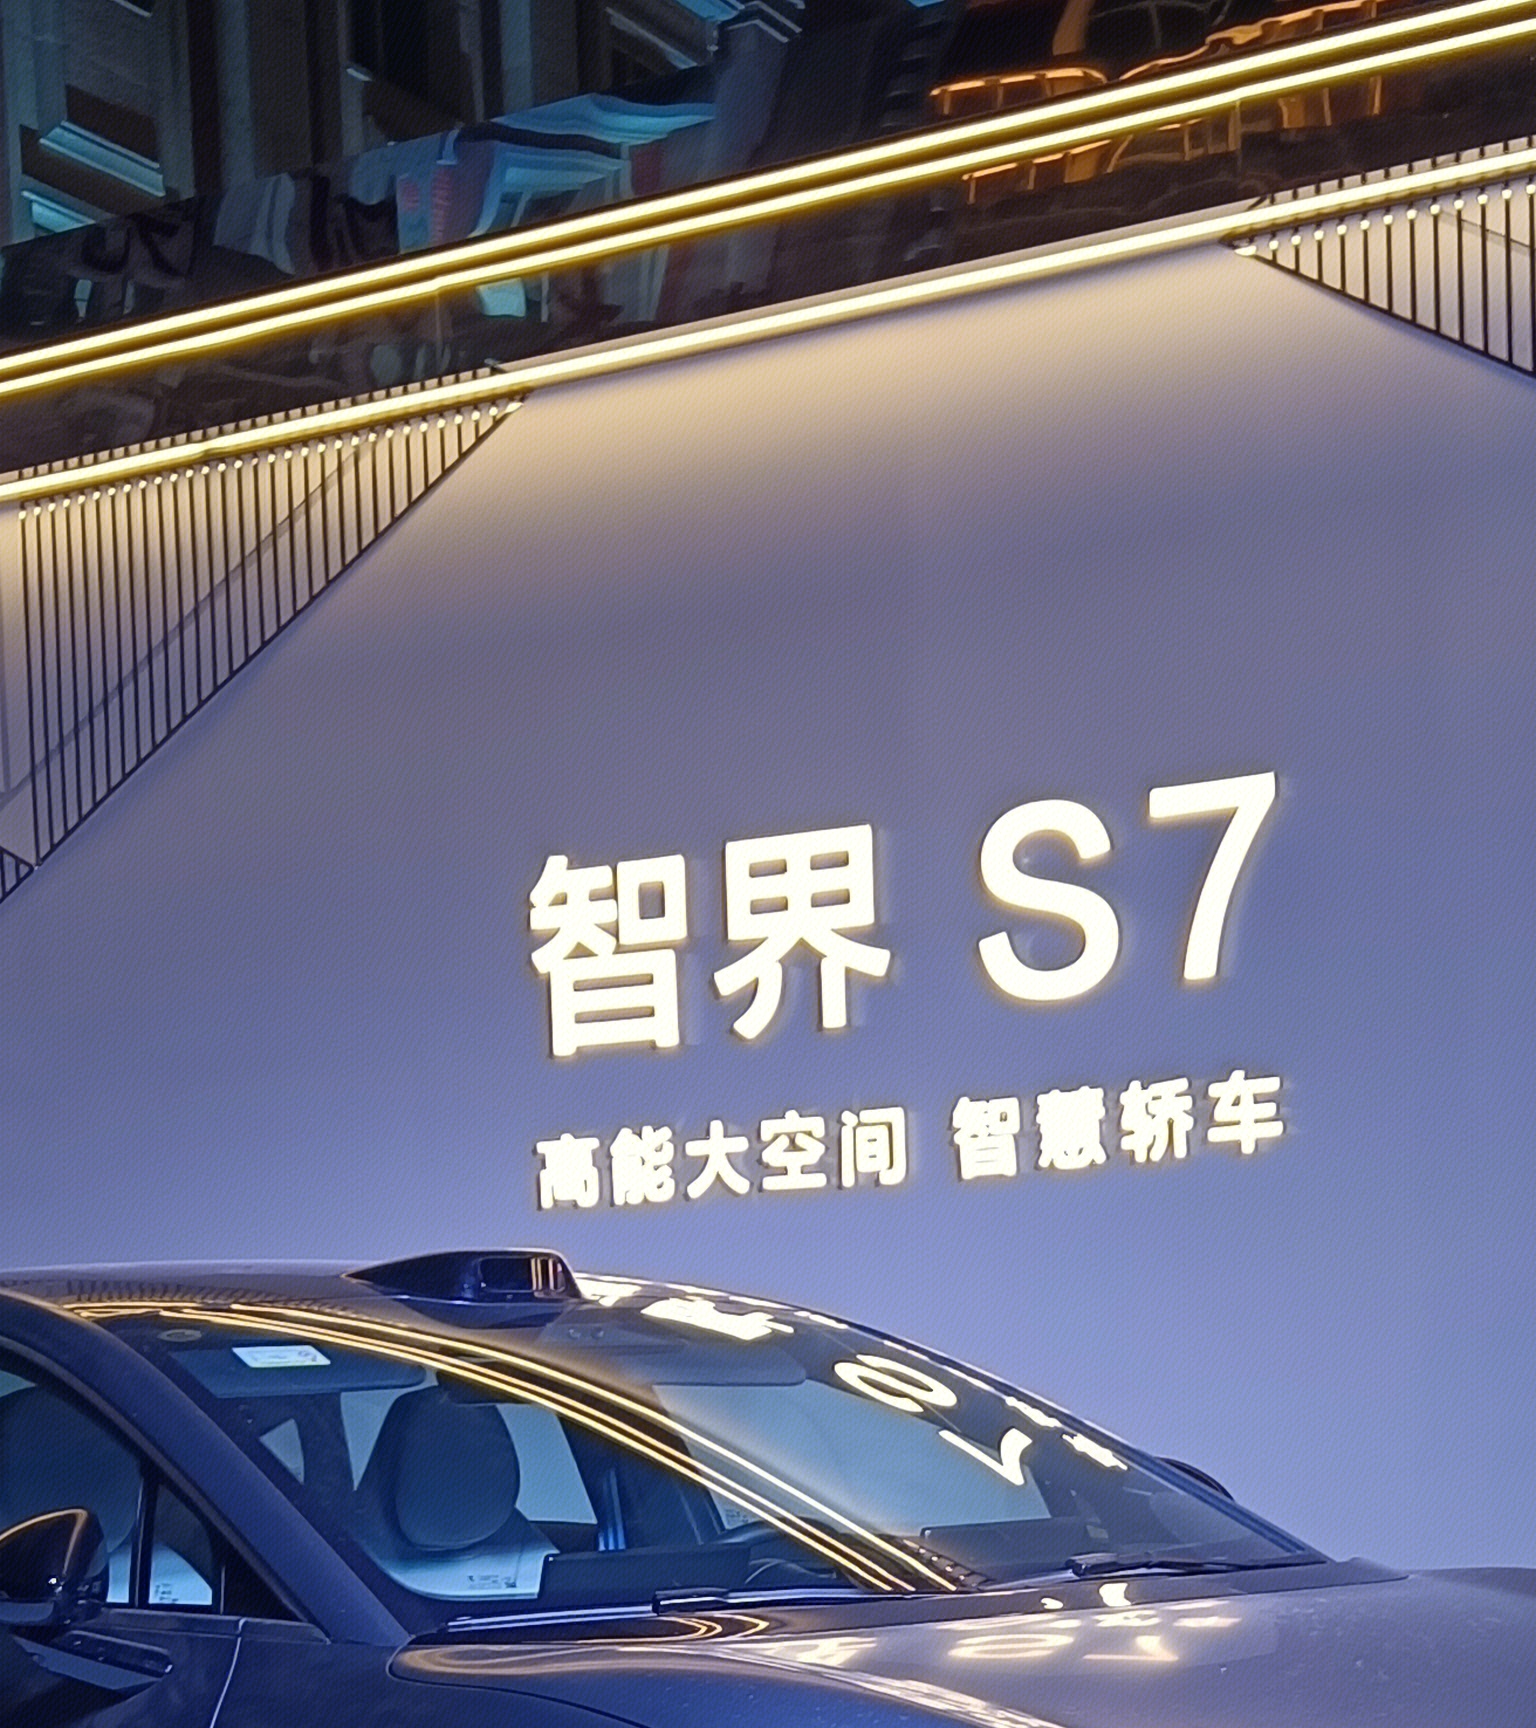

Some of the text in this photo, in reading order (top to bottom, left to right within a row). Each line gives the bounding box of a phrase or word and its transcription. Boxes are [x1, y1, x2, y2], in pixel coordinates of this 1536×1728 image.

[529, 769, 1278, 1058] 智界 S7
[536, 1068, 1286, 1210] 高能大空间 智慧轿车
